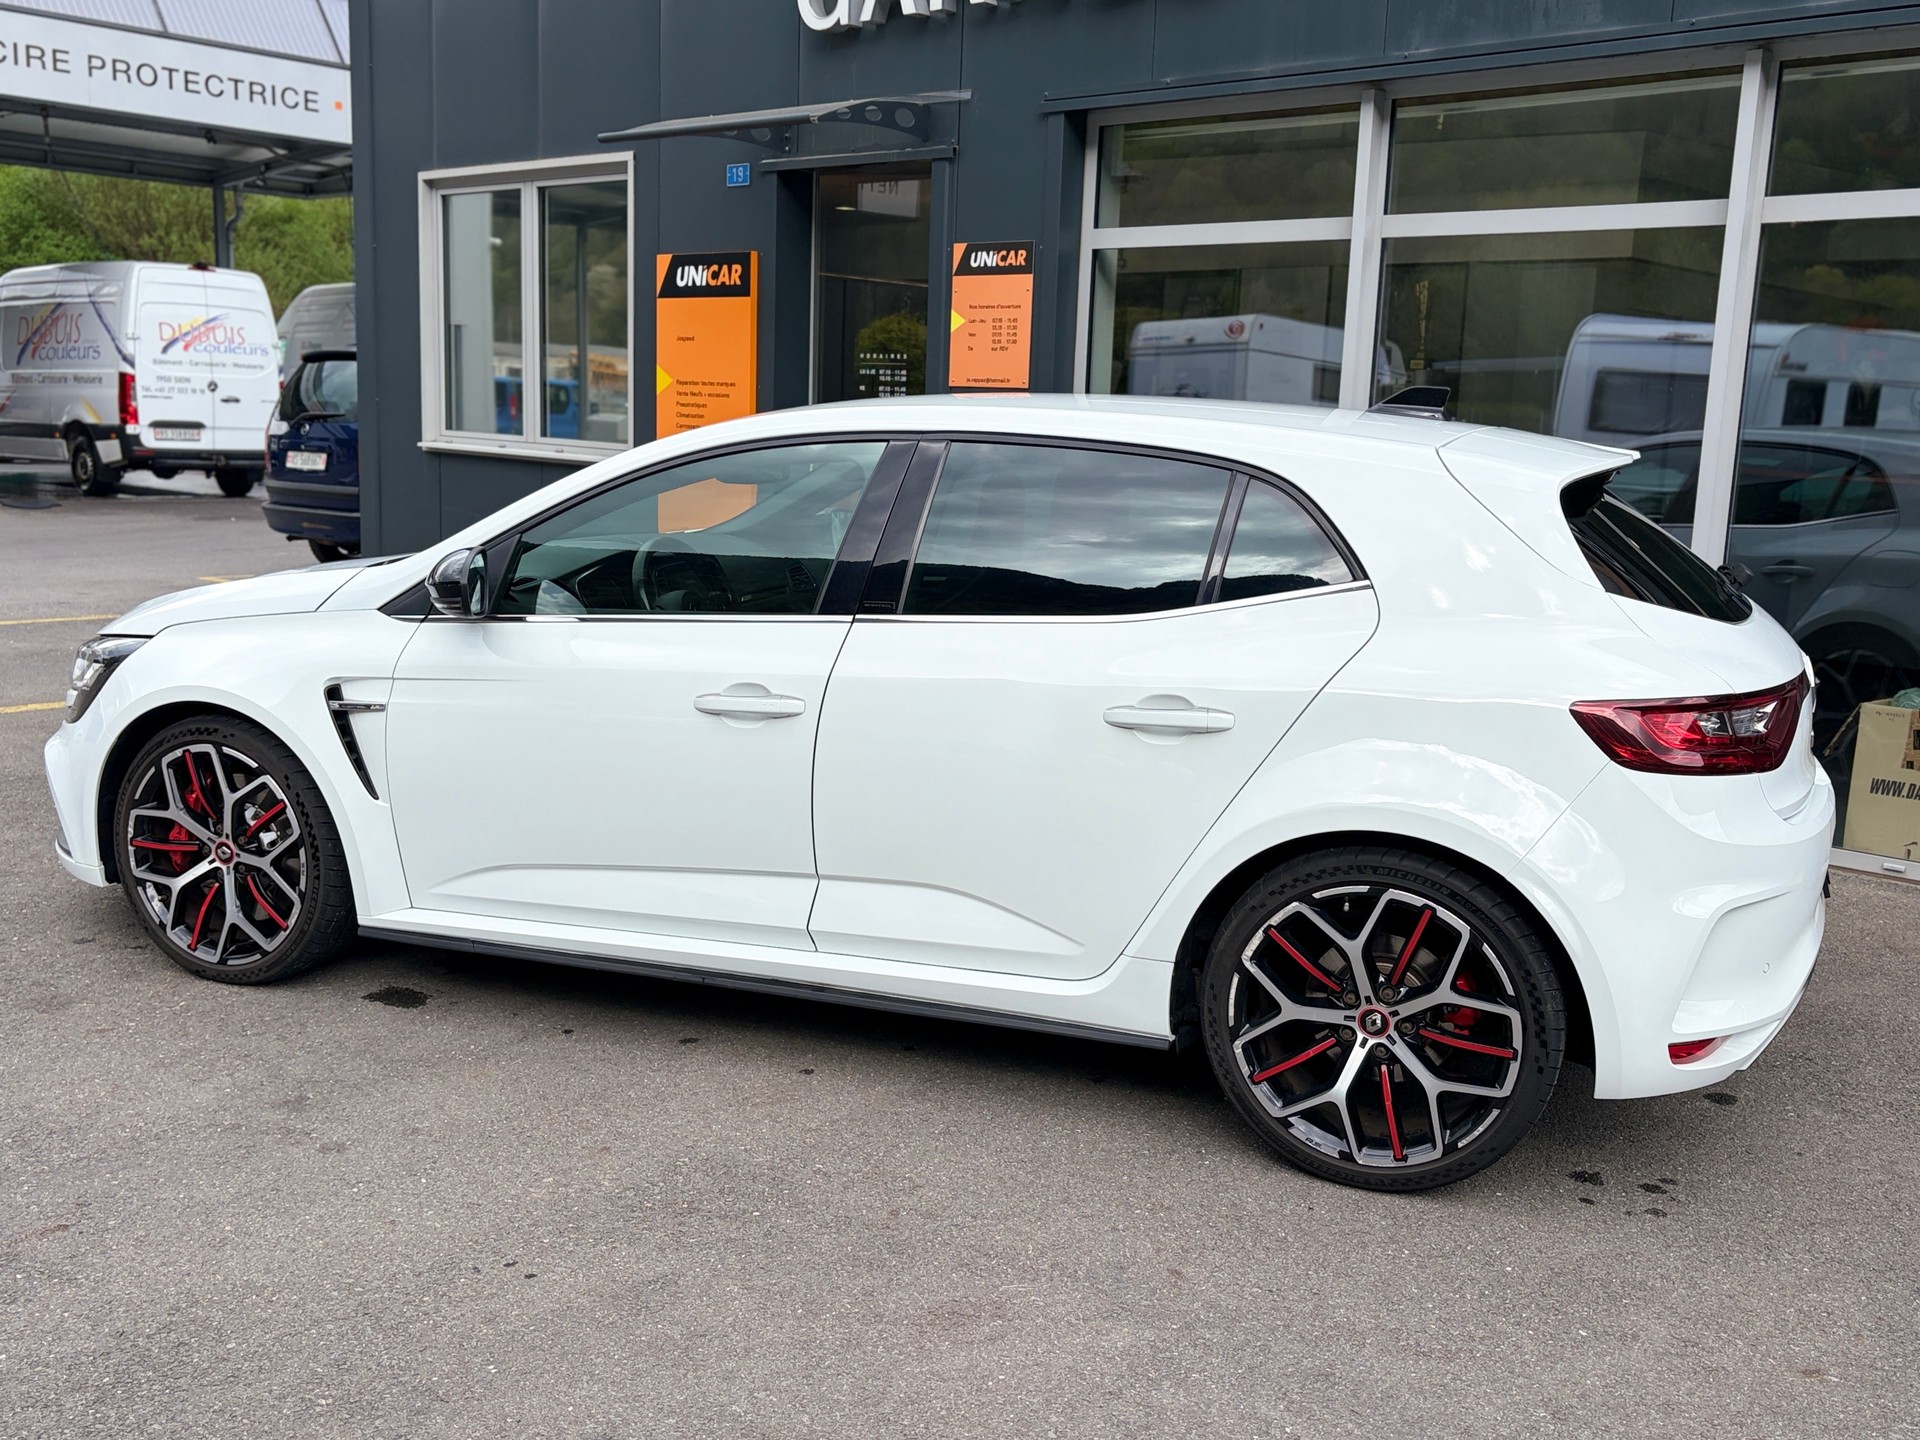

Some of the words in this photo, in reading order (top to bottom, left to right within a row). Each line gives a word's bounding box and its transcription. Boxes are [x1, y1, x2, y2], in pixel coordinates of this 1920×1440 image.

[87, 54, 321, 113] PROTECTRICE
[732, 167, 744, 182] 19
[38, 332, 101, 361] couleurs
[193, 338, 269, 357] couleurs
[676, 400, 707, 409] Pneumatiques
[676, 411, 705, 419] Climatisation
[1375, 867, 1452, 895] MICHELIN
